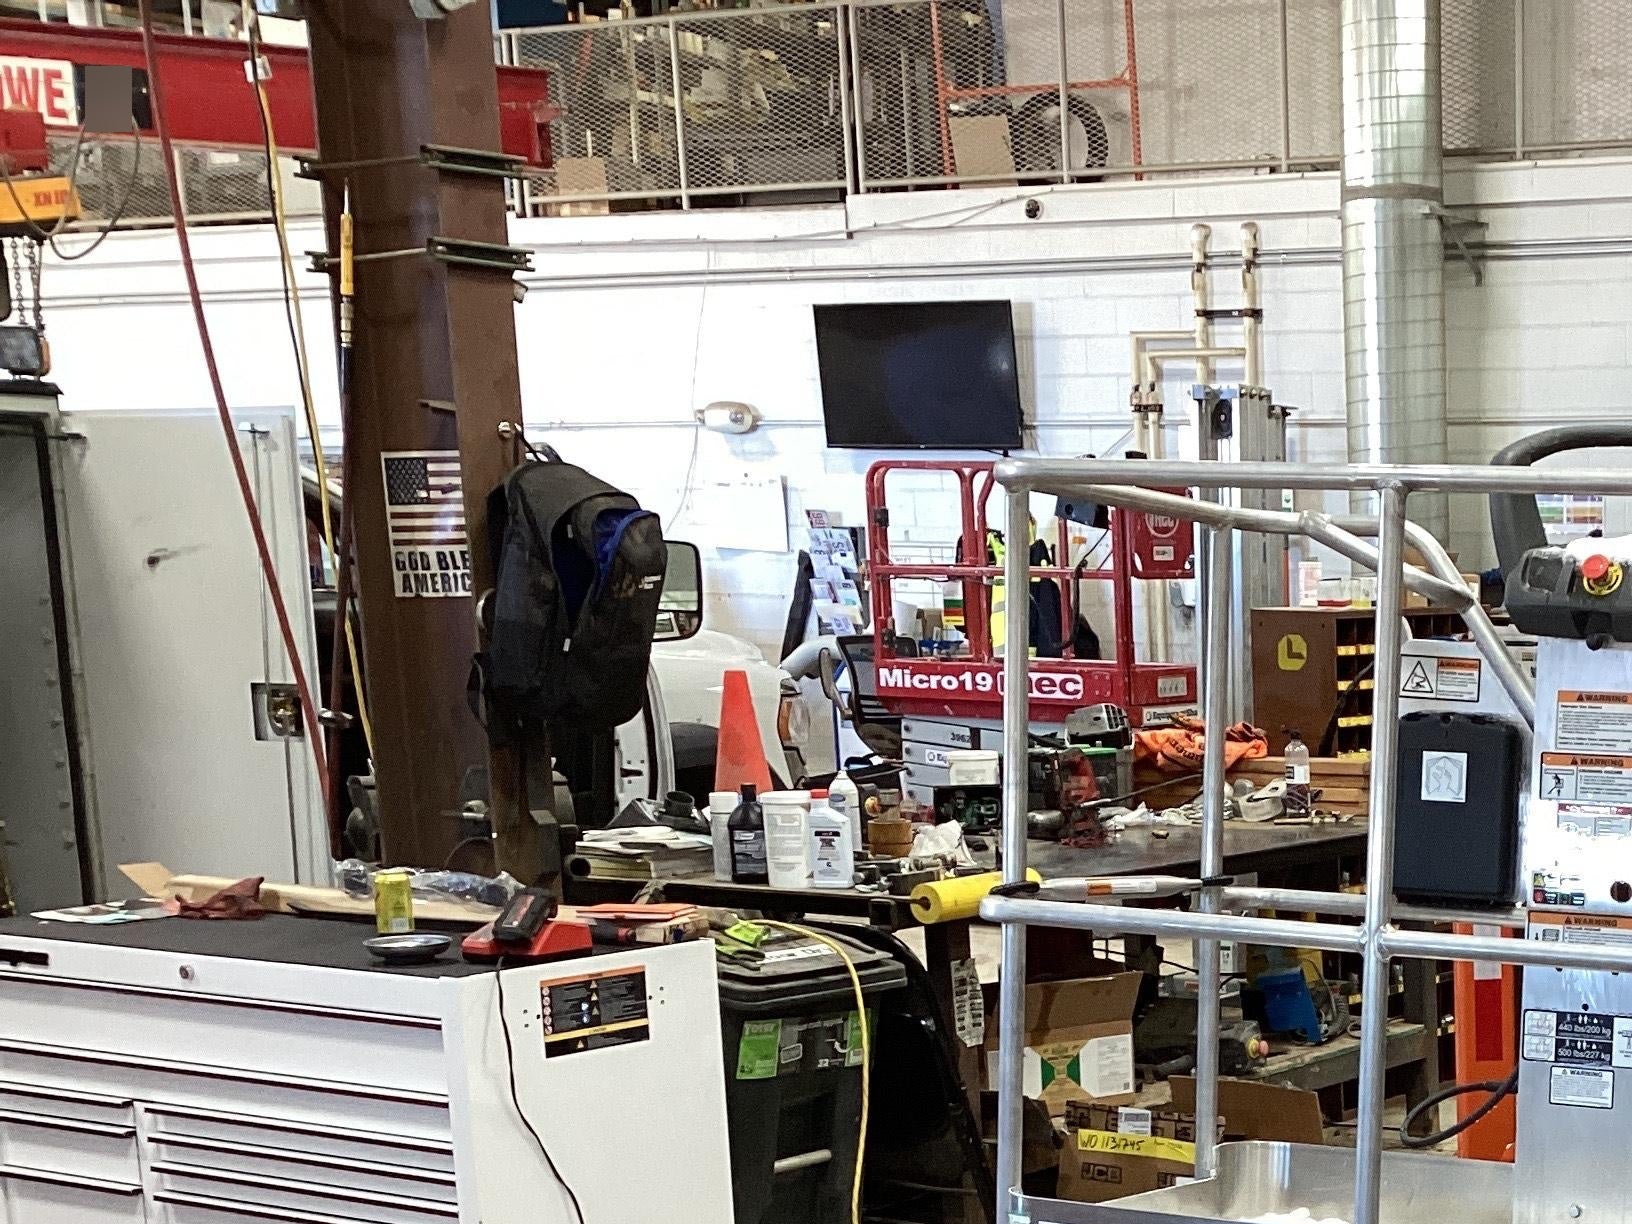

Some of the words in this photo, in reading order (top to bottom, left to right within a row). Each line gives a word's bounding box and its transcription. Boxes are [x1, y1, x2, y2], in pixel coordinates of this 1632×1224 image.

[0, 65, 68, 118] WE
[395, 551, 431, 571] GOD
[878, 667, 993, 692] Micro19
[1585, 694, 1628, 703] WARNING
[1580, 758, 1624, 768] WARNING
[1573, 916, 1618, 928] WARNING
